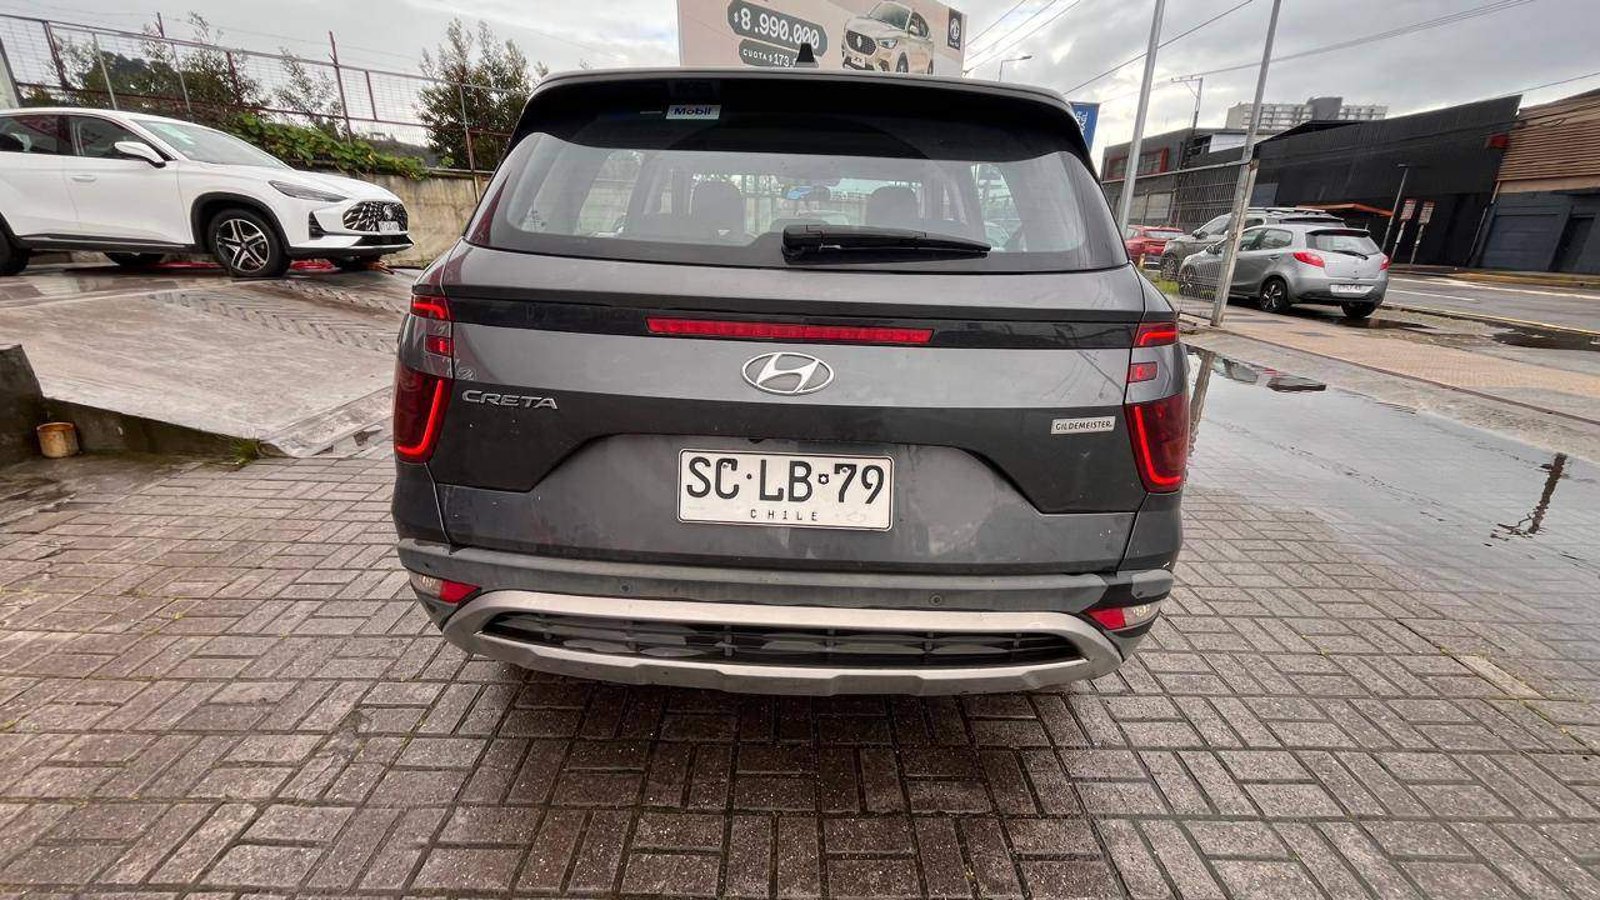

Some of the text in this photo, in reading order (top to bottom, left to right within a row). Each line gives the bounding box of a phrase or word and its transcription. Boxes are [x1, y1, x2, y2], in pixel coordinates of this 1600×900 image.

[743, 48, 767, 61] CUOTA
[674, 107, 712, 116] Mobil
[461, 389, 558, 410] CRETA
[1055, 420, 1112, 431] GILDEMEISTER
[750, 509, 818, 522] CHILE
